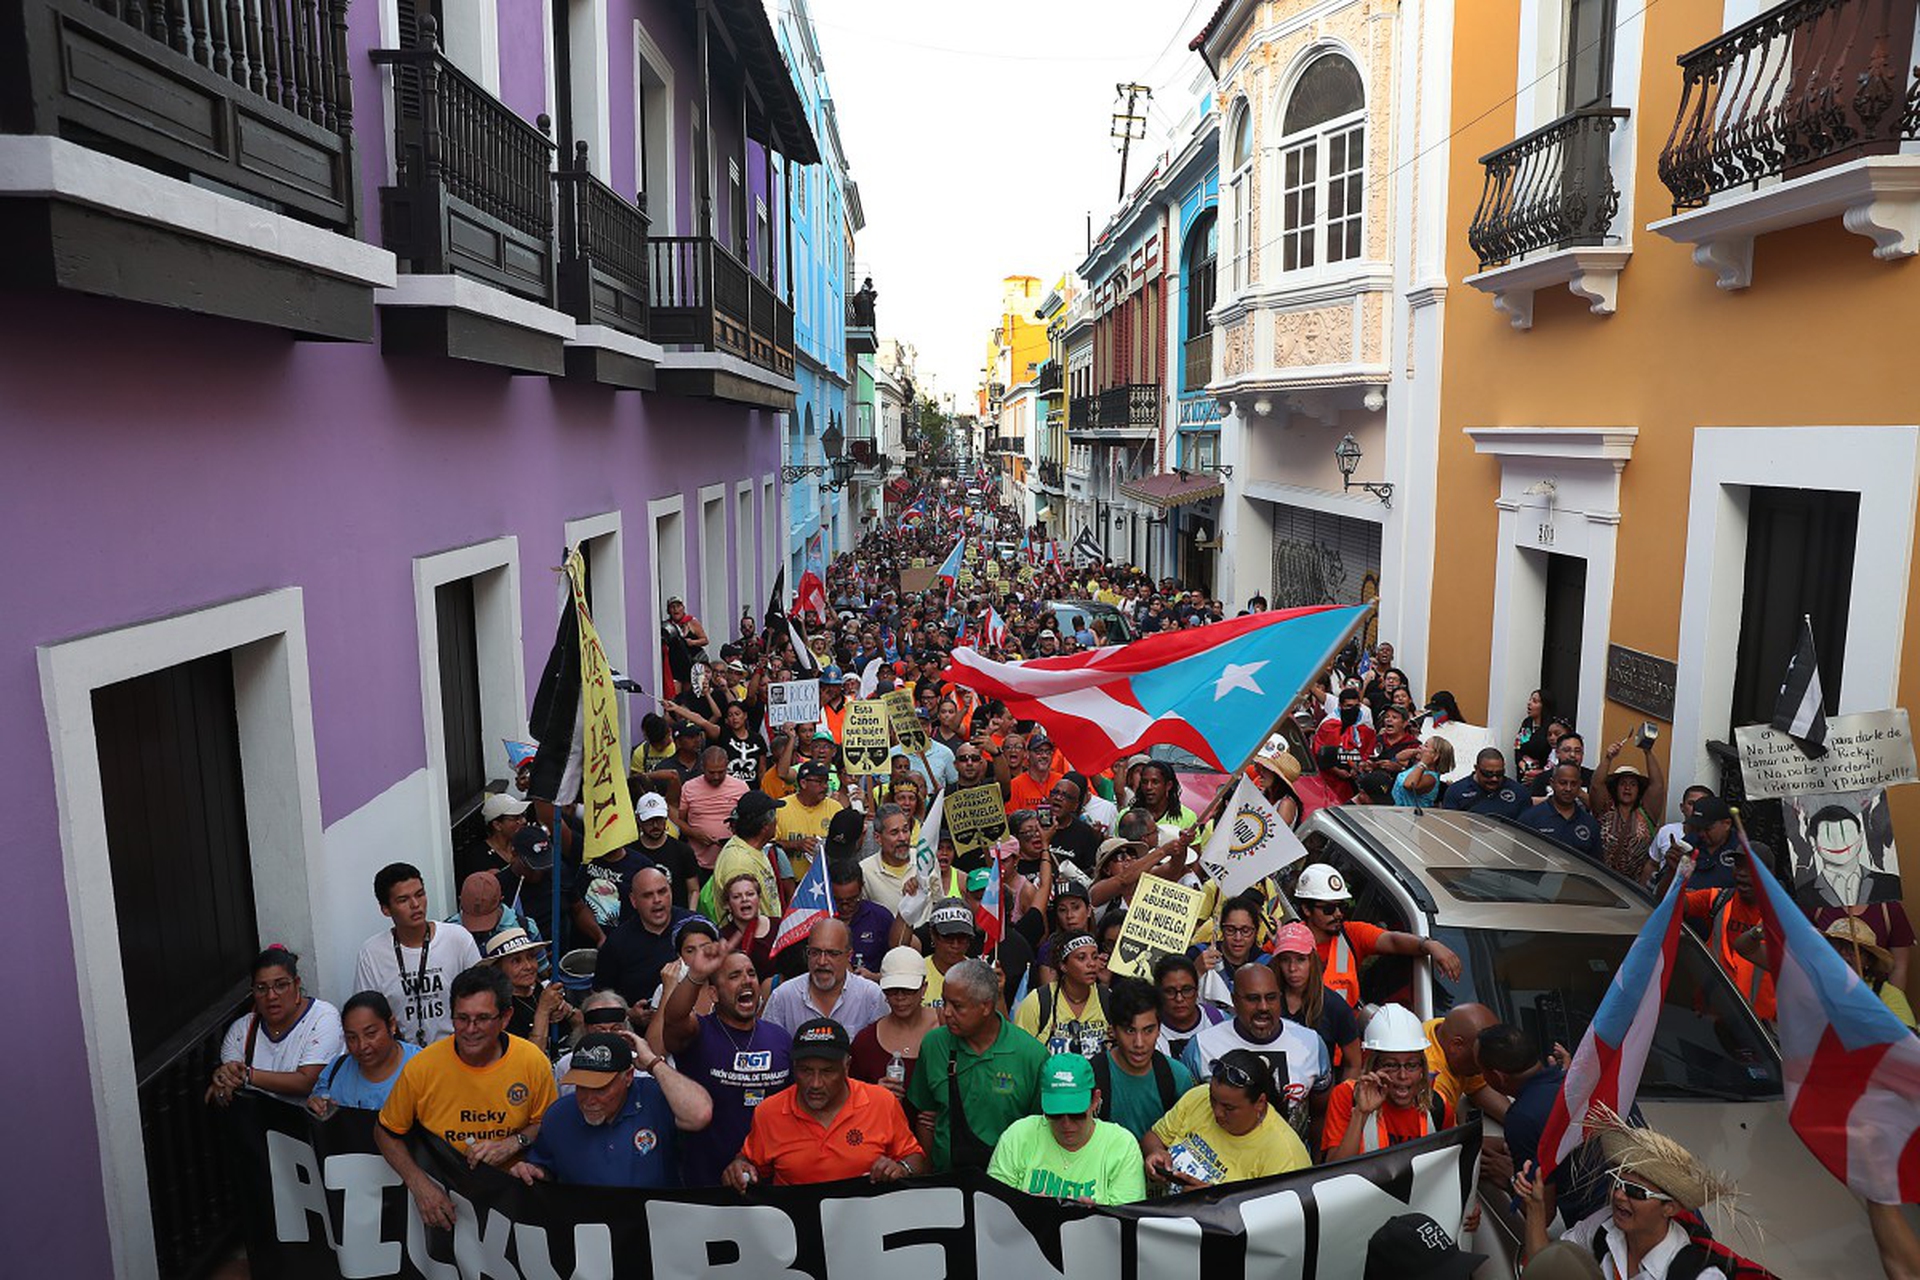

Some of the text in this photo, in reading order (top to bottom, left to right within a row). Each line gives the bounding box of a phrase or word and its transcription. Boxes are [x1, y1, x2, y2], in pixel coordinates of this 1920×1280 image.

[770, 704, 818, 723] RENUNCIA
[1746, 743, 1764, 756] No
[1151, 882, 1191, 904] SI SIGUEN
[1133, 906, 1188, 937] UNA HUELGA
[460, 1110, 507, 1123] Ricky
